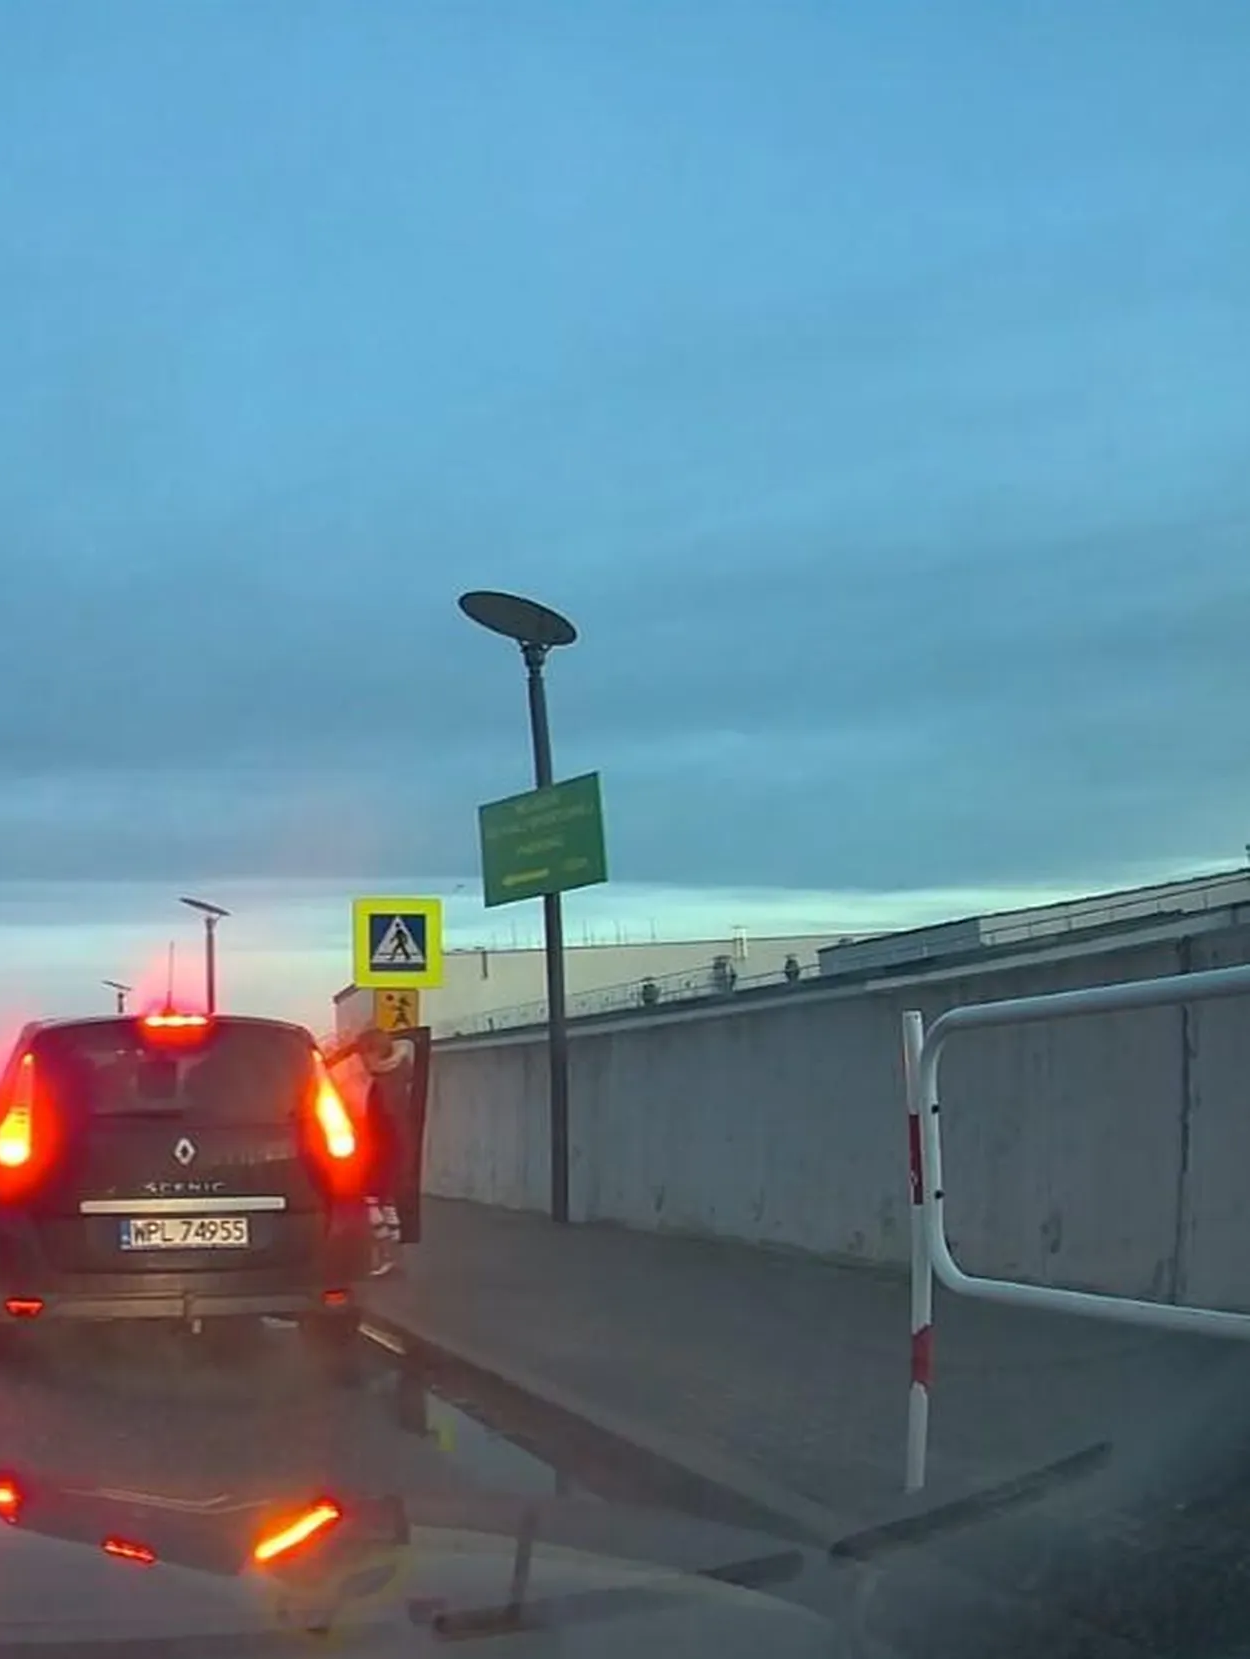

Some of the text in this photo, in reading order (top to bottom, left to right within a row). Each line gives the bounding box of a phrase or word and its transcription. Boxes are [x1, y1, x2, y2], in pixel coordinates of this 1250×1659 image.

[145, 1182, 226, 1193] SCENIC
[133, 1220, 245, 1243] WPL 74955
